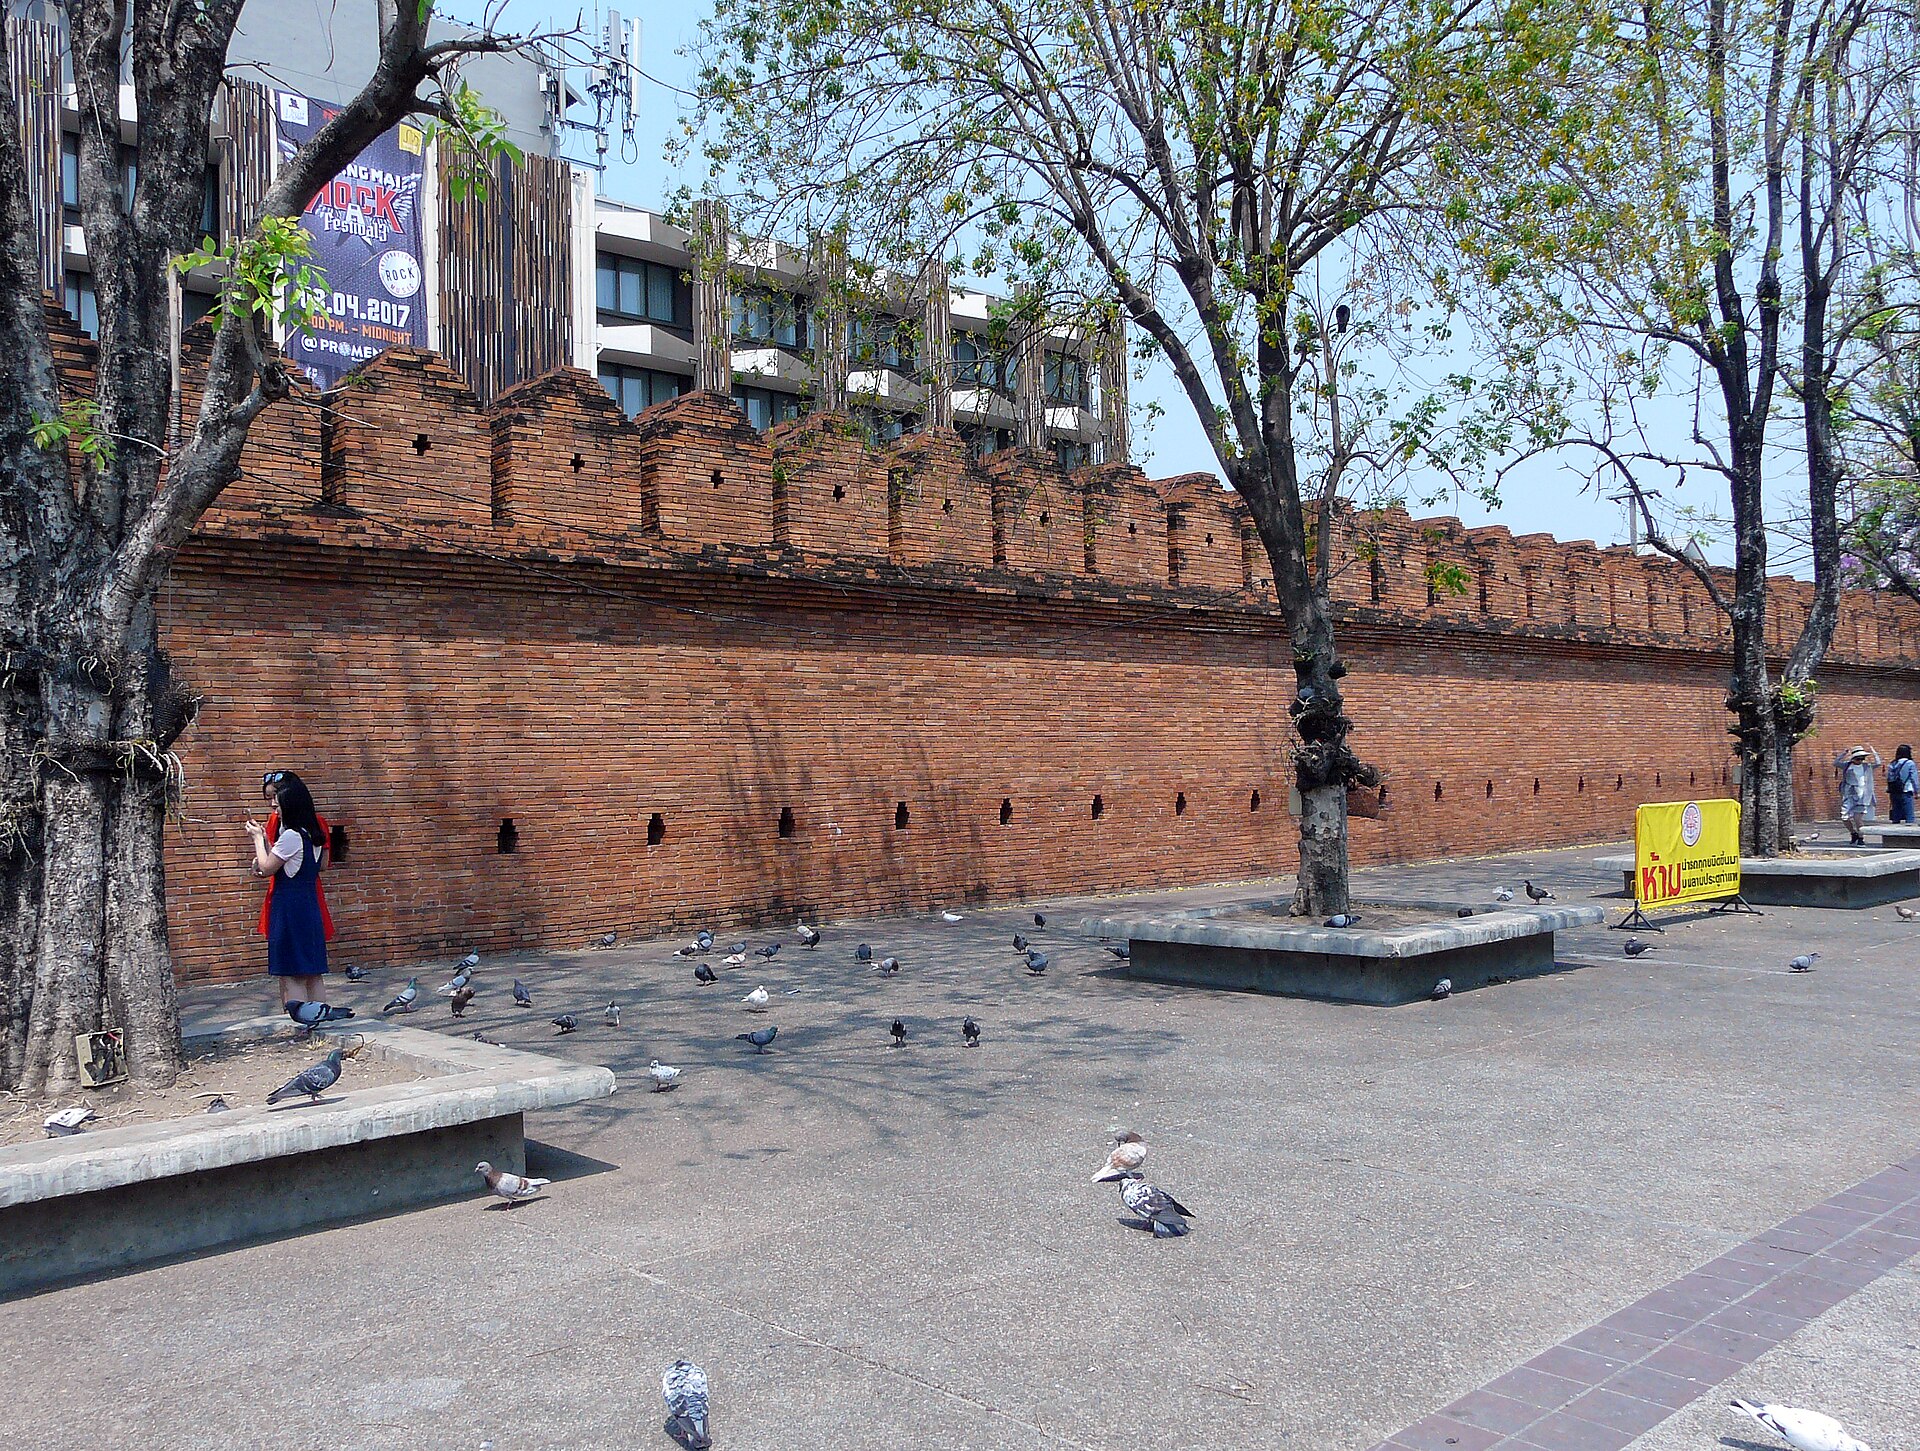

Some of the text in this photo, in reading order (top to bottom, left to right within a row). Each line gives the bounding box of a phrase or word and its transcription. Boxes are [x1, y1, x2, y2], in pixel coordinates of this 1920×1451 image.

[370, 168, 401, 189] MAI
[385, 267, 415, 281] ROCK
[390, 283, 414, 294] MUSIC
[301, 334, 318, 352] @
[362, 324, 412, 345] MIDNIGHT
[1642, 852, 1681, 901] ห้าม
